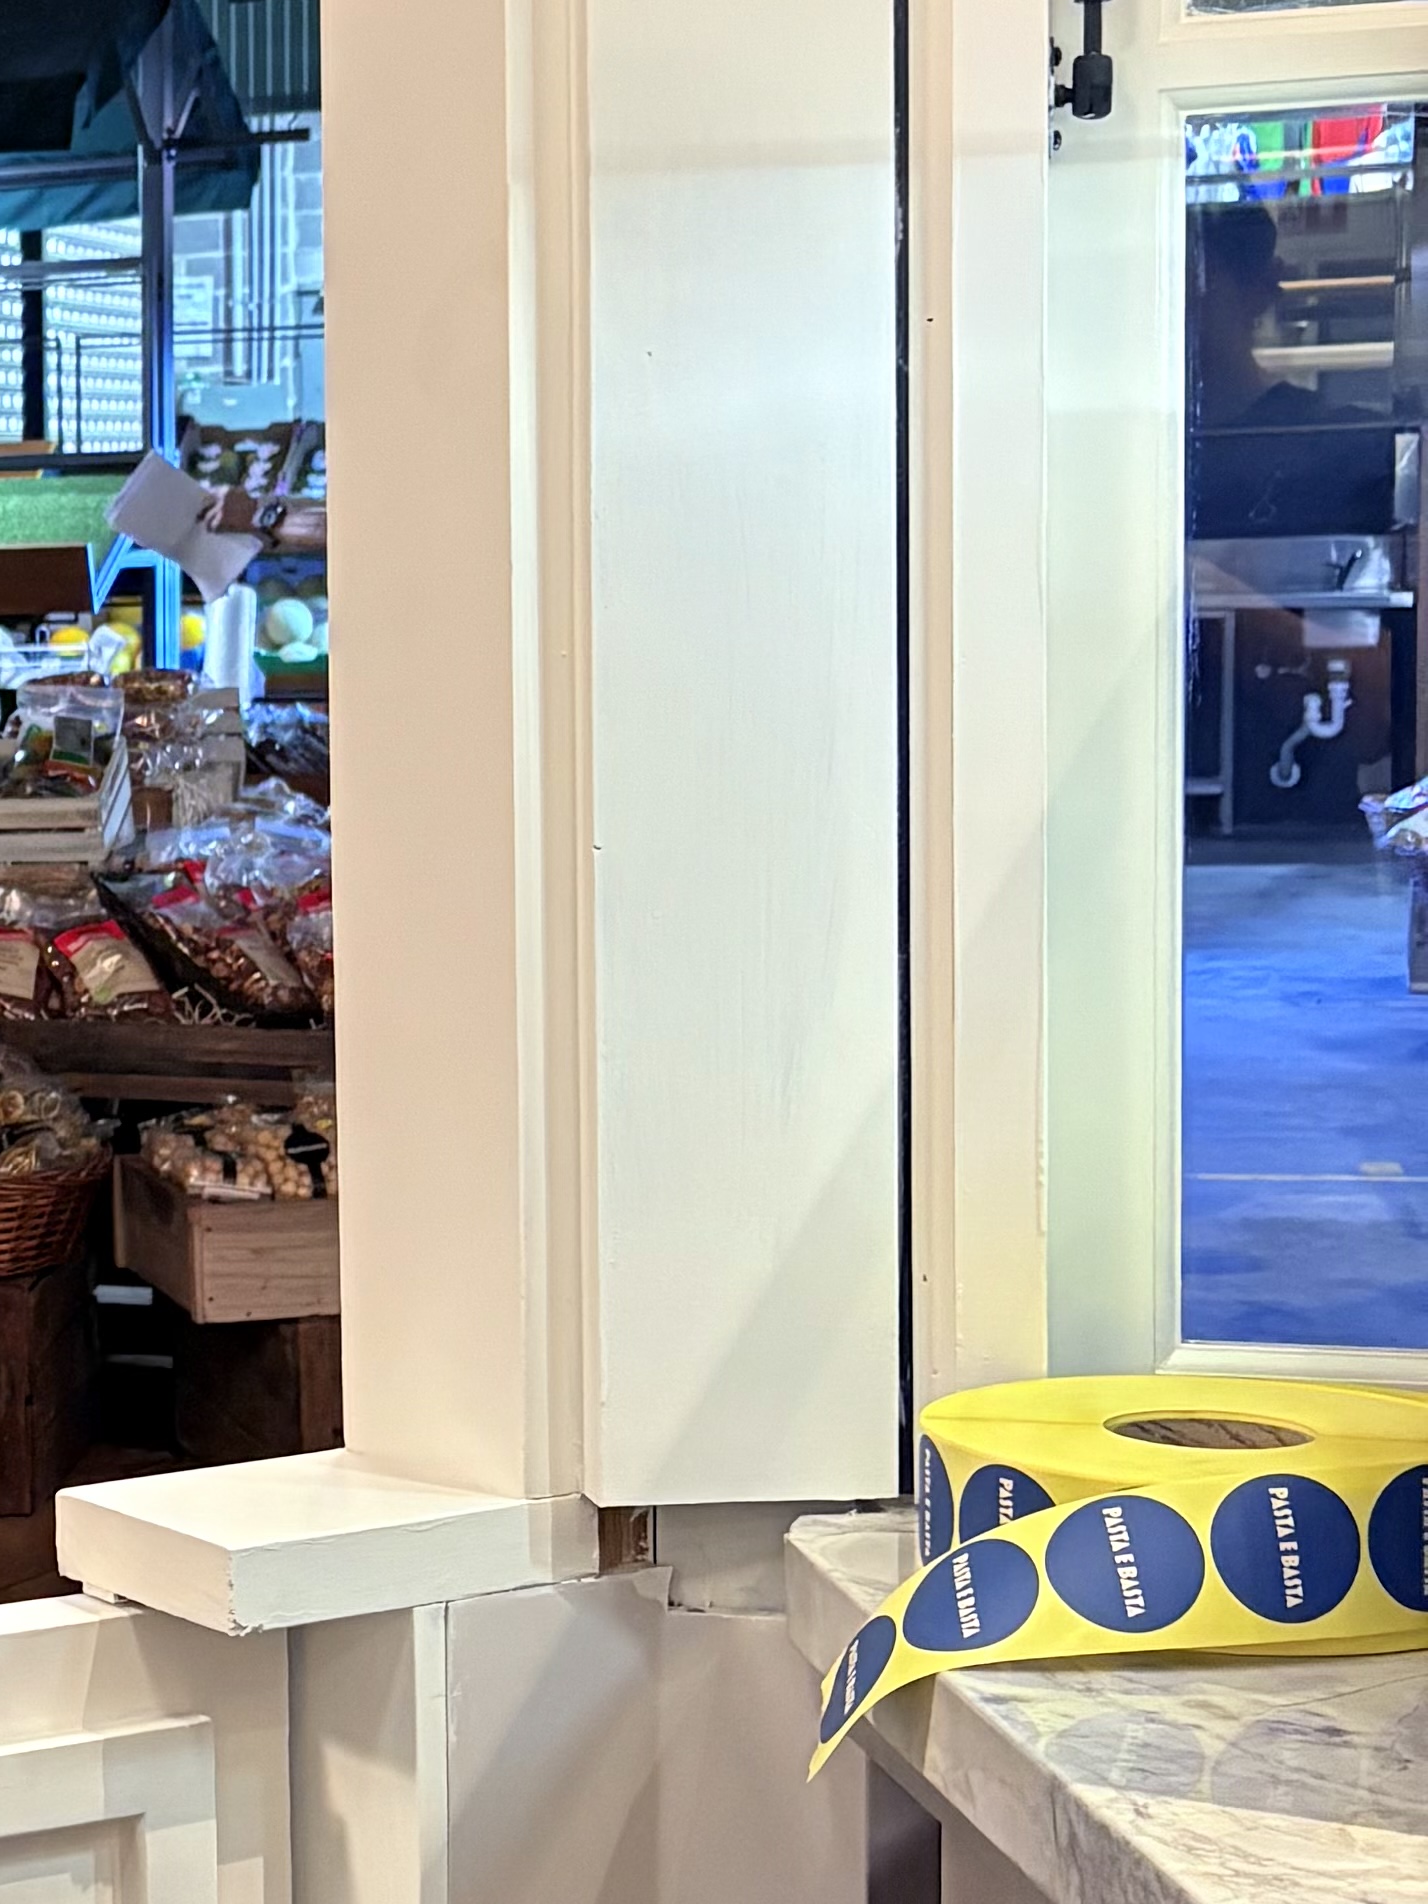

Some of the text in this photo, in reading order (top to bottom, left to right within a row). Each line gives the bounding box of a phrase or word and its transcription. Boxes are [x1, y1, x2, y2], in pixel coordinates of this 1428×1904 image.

[1102, 1506, 1146, 1618] PASTA E BASTA
[1268, 1487, 1304, 1609] PASTA E BASTA
